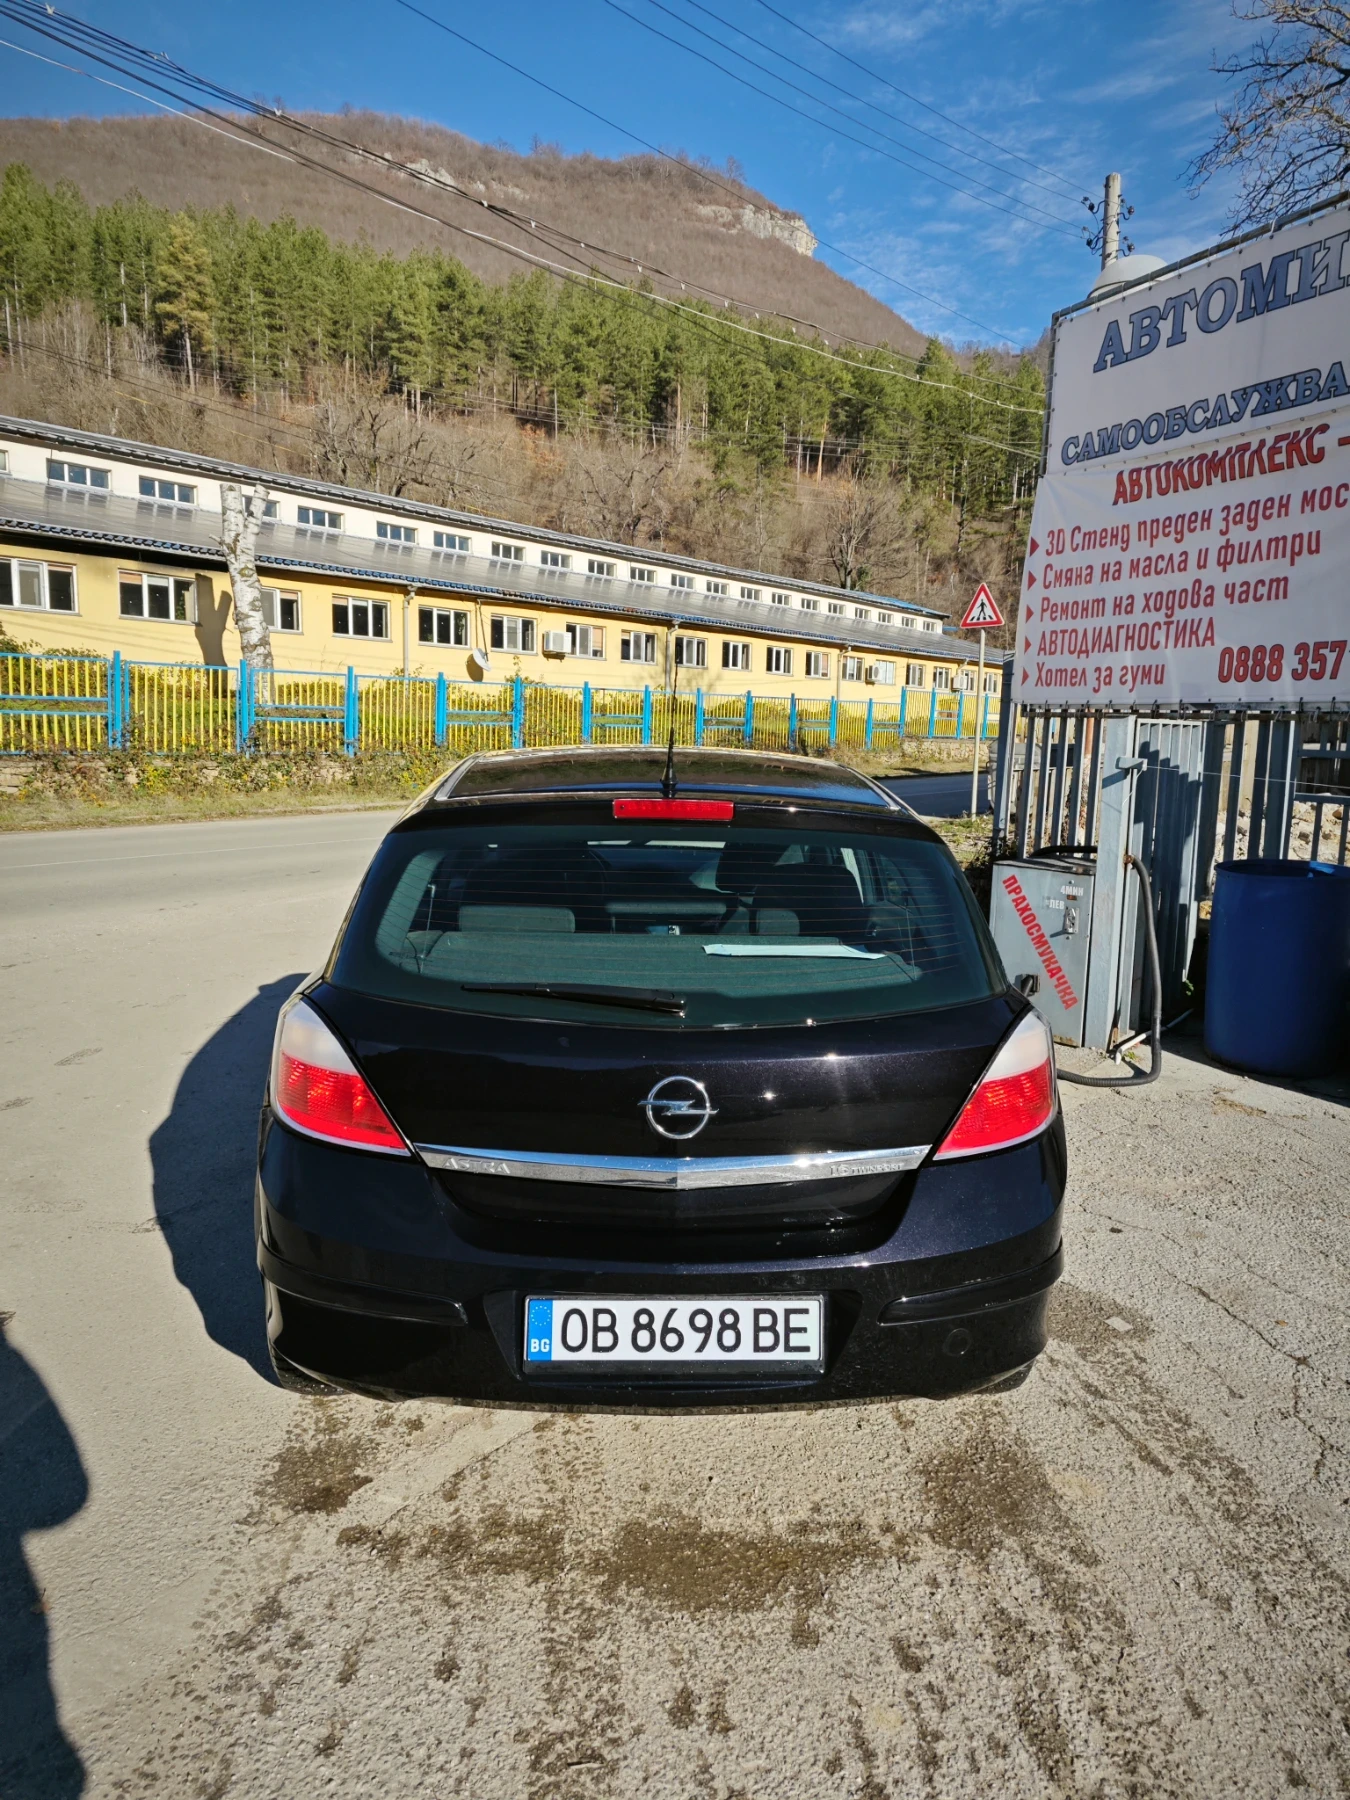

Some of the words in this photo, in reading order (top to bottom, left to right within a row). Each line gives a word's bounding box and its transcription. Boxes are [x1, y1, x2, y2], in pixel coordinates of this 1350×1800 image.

[1093, 229, 1350, 374] АВТОМИ
[1061, 361, 1350, 466] САМООБСЛУЖВА
[1112, 423, 1330, 505] АВТОКОМПЛЕКС
[1045, 528, 1066, 556] 3D
[1070, 525, 1131, 552] Стенд
[1137, 508, 1213, 548] преден
[1219, 494, 1291, 536] заден
[1300, 482, 1350, 514] мос
[1042, 563, 1094, 589] Смяна
[1100, 560, 1122, 583] на
[1129, 550, 1189, 579] масла
[1196, 547, 1209, 570] и
[1216, 529, 1321, 573] филтри
[1040, 597, 1106, 622] Ремонт
[1112, 594, 1135, 616] на
[1141, 578, 1216, 619] ходова
[1224, 576, 1289, 605] част
[1037, 616, 1215, 659] АВТОДИАГНОСТИКА
[1034, 662, 1088, 687] Хотел
[1092, 665, 1113, 694] за
[1118, 664, 1166, 693] гуми
[1218, 643, 1284, 682] 0888
[1291, 640, 1348, 681] 357
[1002, 874, 1079, 1011] ПРАХОСМУКАЧКА
[442, 1158, 510, 1174] ASTRA
[530, 1338, 550, 1352] BG
[561, 1308, 619, 1353] OB
[631, 1308, 742, 1353] 8698
[753, 1308, 811, 1353] BE
